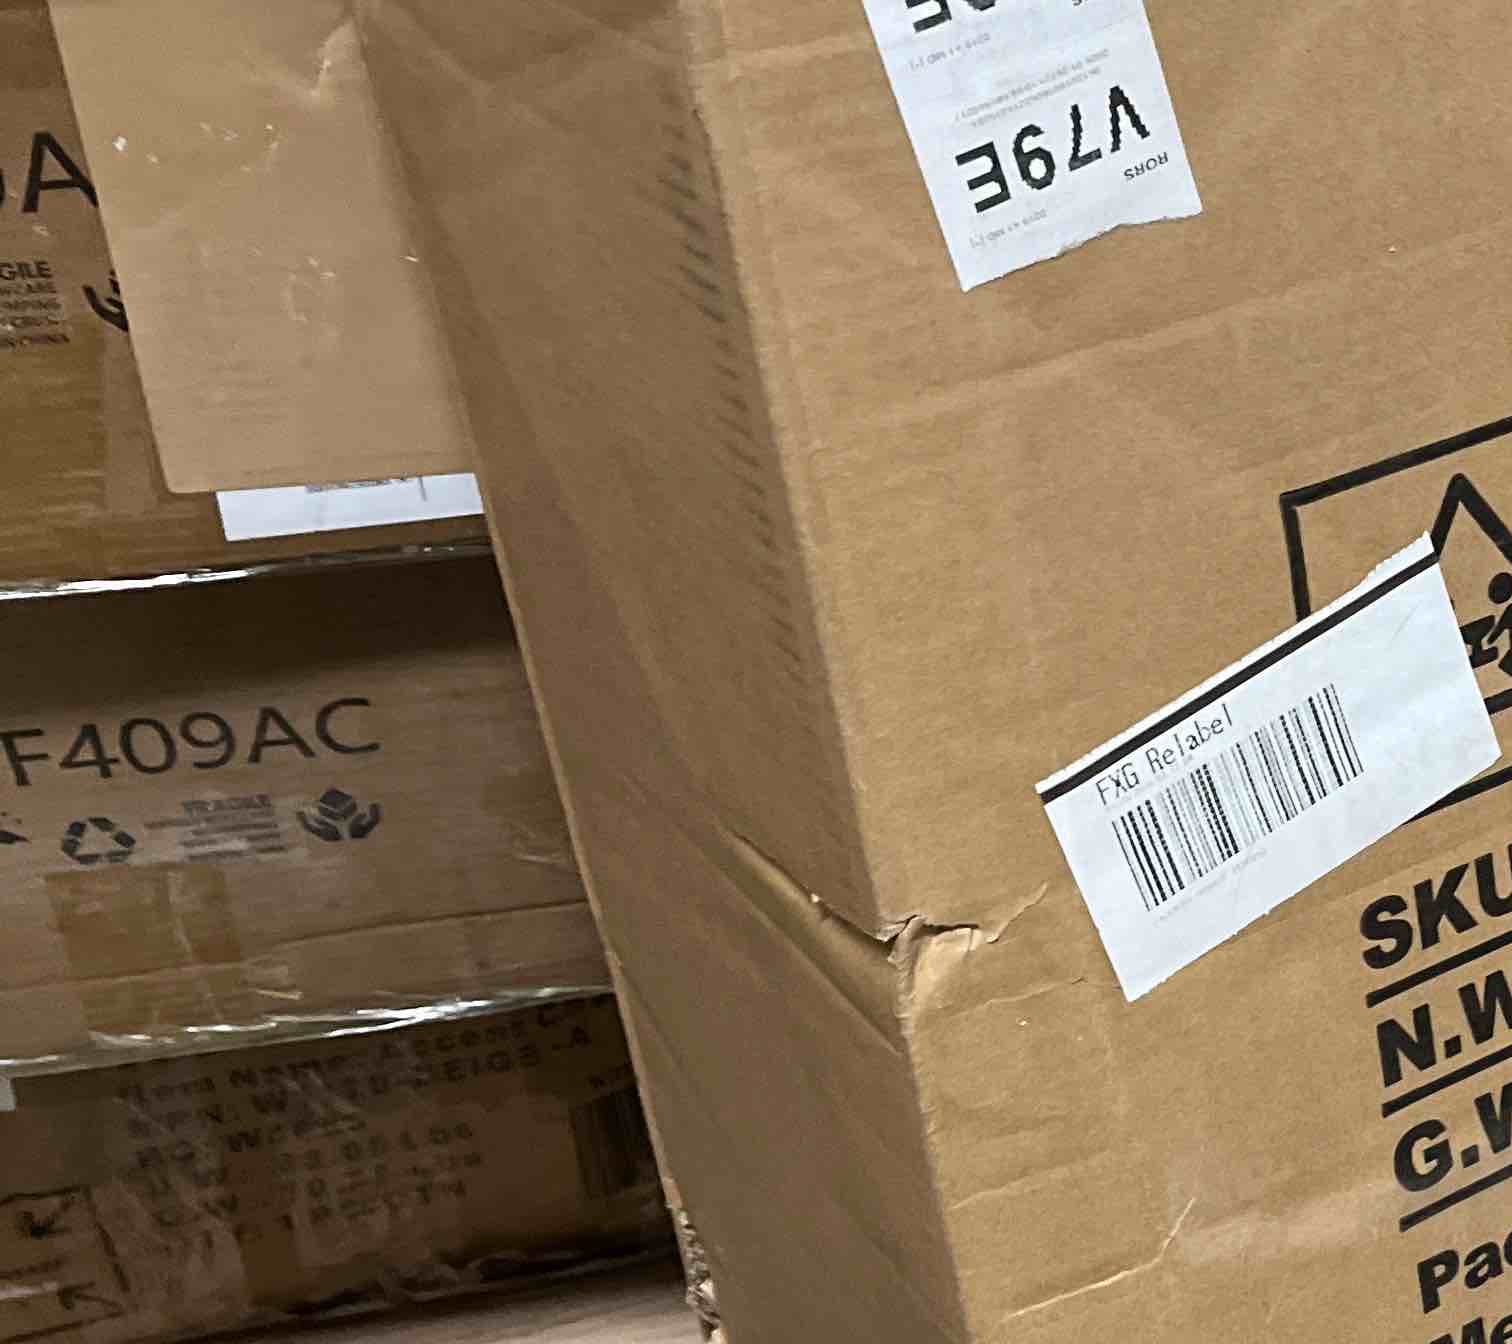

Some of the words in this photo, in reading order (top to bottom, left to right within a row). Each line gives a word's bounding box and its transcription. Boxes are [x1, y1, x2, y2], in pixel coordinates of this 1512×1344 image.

[955, 85, 1150, 214] V79E
[1123, 151, 1169, 181] RORS
[0, 697, 381, 787] F409AC
[1096, 761, 1140, 807] FXG
[1145, 703, 1233, 770] Relabel
